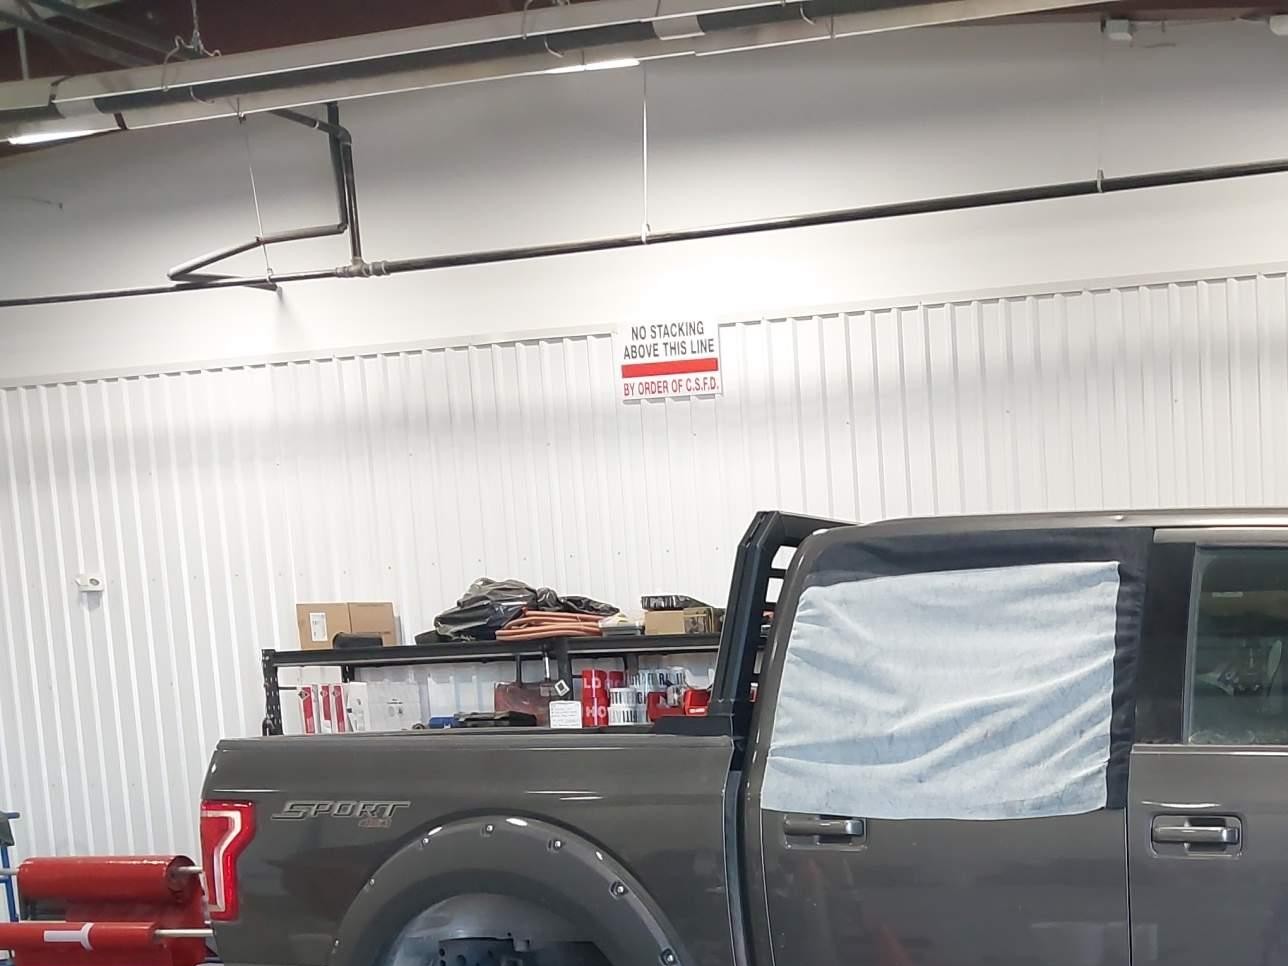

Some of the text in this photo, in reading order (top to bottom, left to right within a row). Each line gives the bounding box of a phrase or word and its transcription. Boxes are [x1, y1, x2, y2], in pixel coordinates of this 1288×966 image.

[631, 320, 704, 341] NO STACKING
[623, 338, 715, 360] ABOVE THIS LINE
[623, 376, 720, 397] BY ORDER OF C.S.F.D.
[270, 799, 411, 820] SPORT
